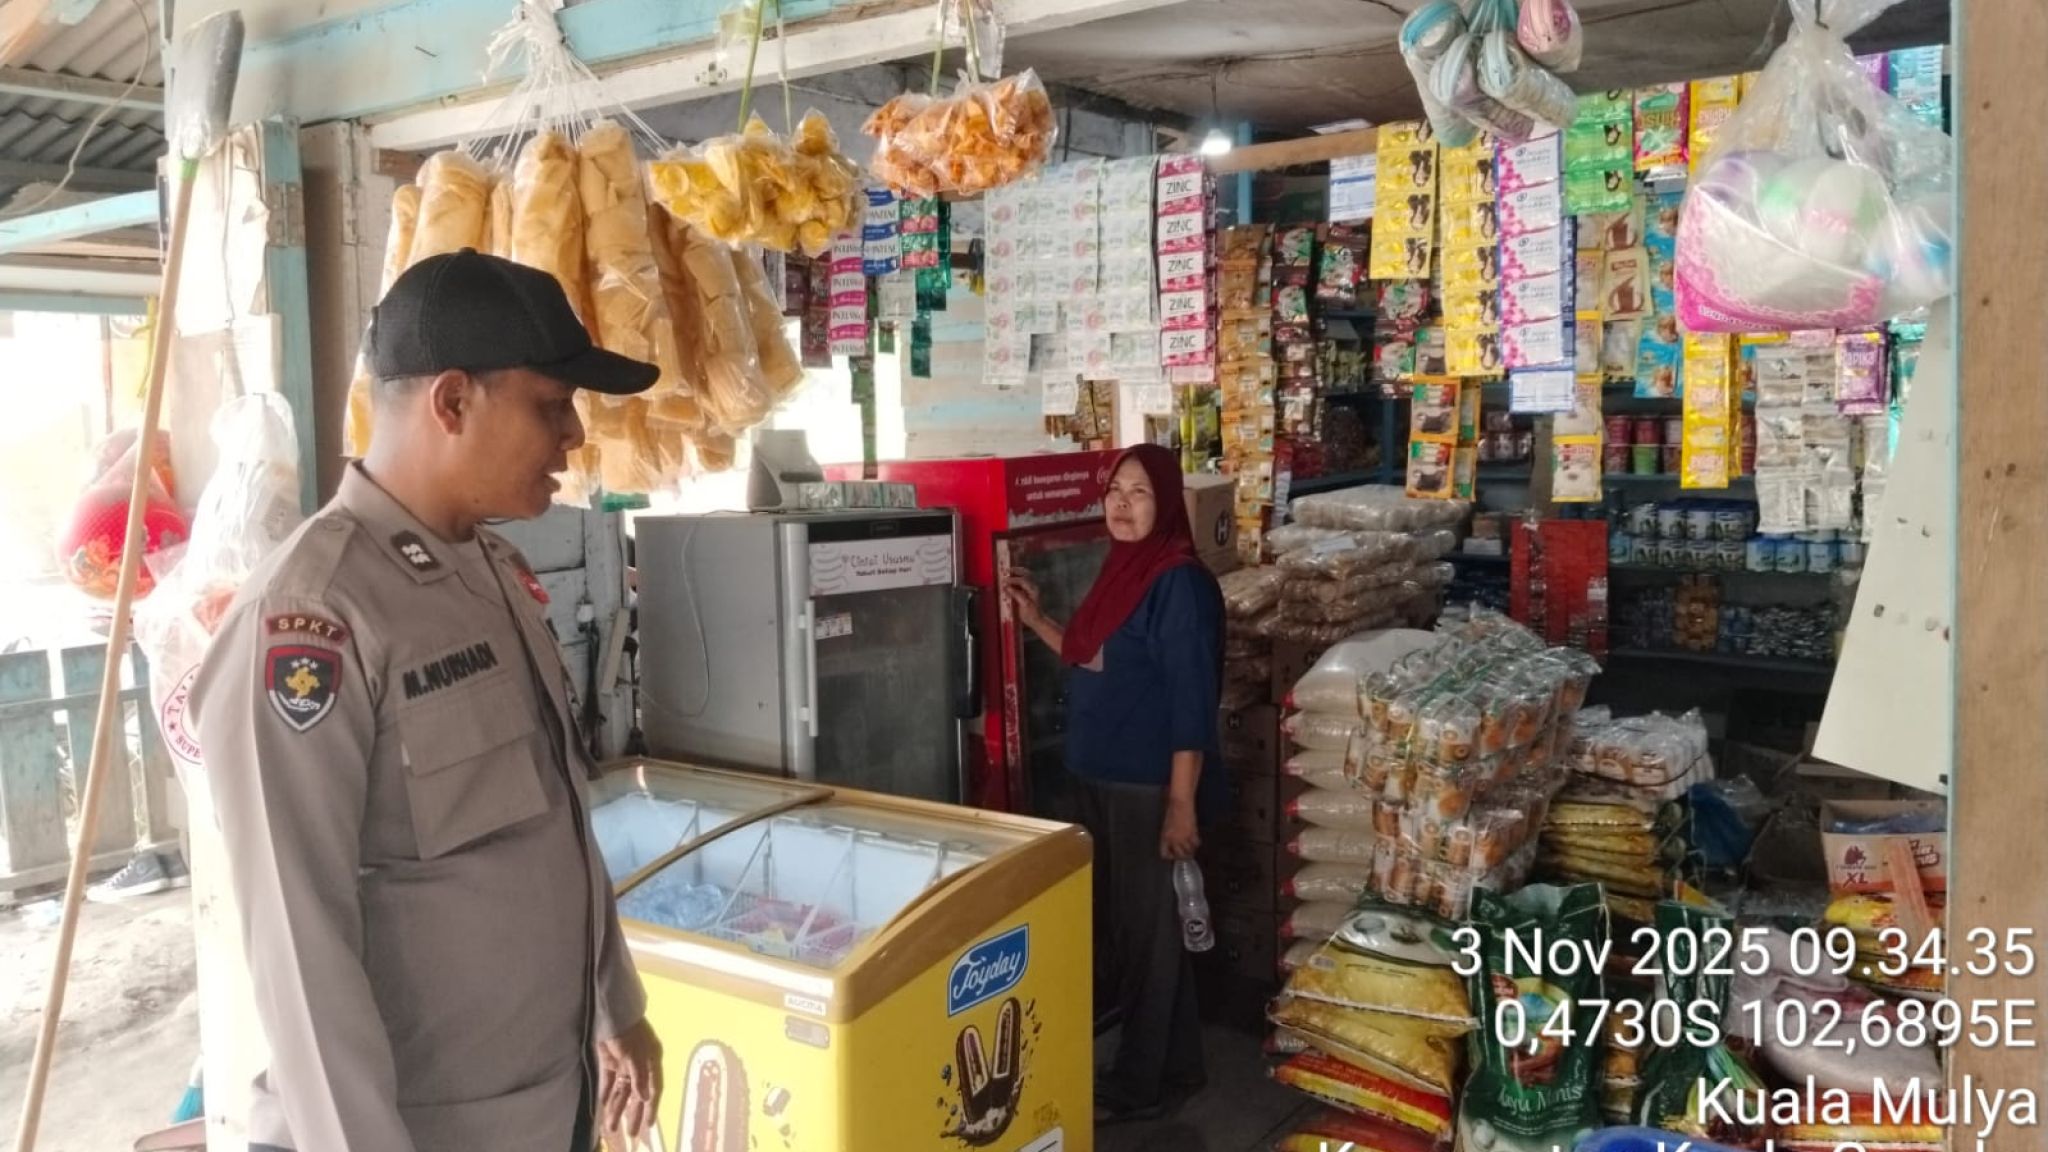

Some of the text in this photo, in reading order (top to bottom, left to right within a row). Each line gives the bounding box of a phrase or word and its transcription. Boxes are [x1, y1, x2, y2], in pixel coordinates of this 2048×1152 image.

[1166, 179, 1192, 194] ZINC
[1166, 219, 1192, 234] ZINC
[1167, 257, 1194, 272] ZINC
[1169, 297, 1196, 311] ZINC
[1169, 335, 1196, 350] ZINC
[278, 617, 337, 637] SPKT
[402, 640, 499, 700] M.NURHADI
[1842, 871, 1869, 889] XL
[952, 950, 1022, 1000] Joyday
